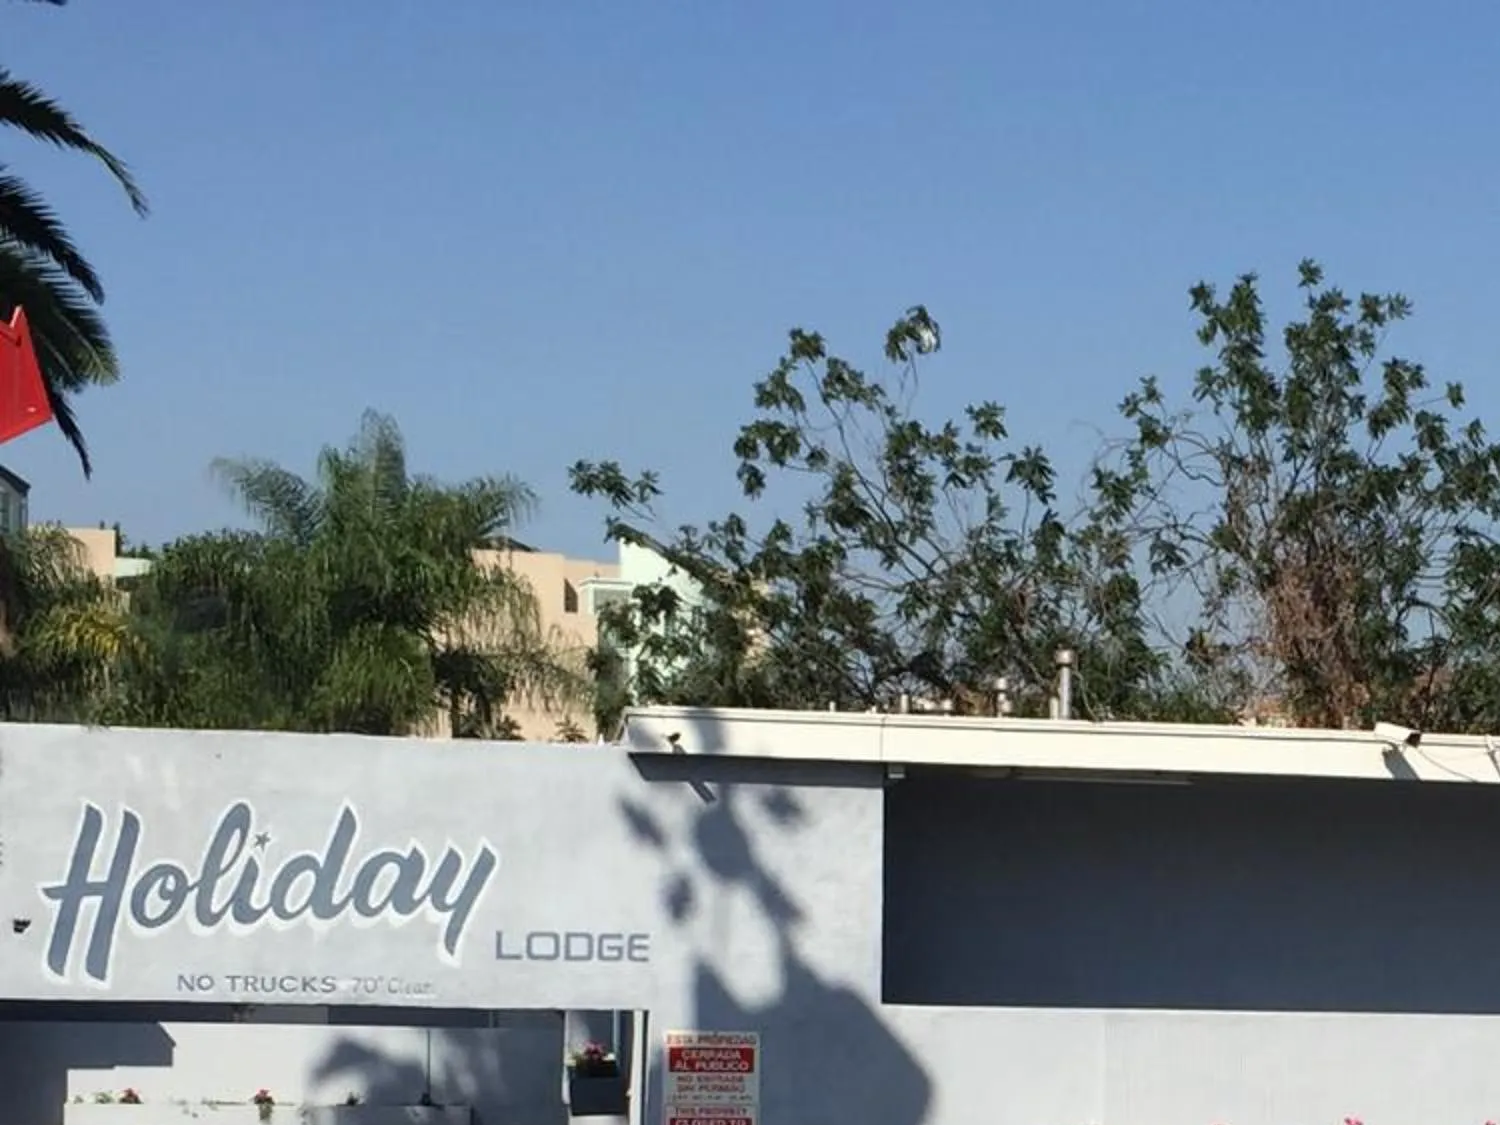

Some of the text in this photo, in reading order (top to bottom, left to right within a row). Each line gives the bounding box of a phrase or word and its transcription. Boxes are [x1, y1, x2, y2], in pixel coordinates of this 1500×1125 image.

[43, 803, 497, 982] Holiday
[496, 929, 651, 962] LODGE
[177, 974, 214, 992] NO
[225, 974, 337, 994] TRUCKS
[674, 1060, 689, 1071] AL
